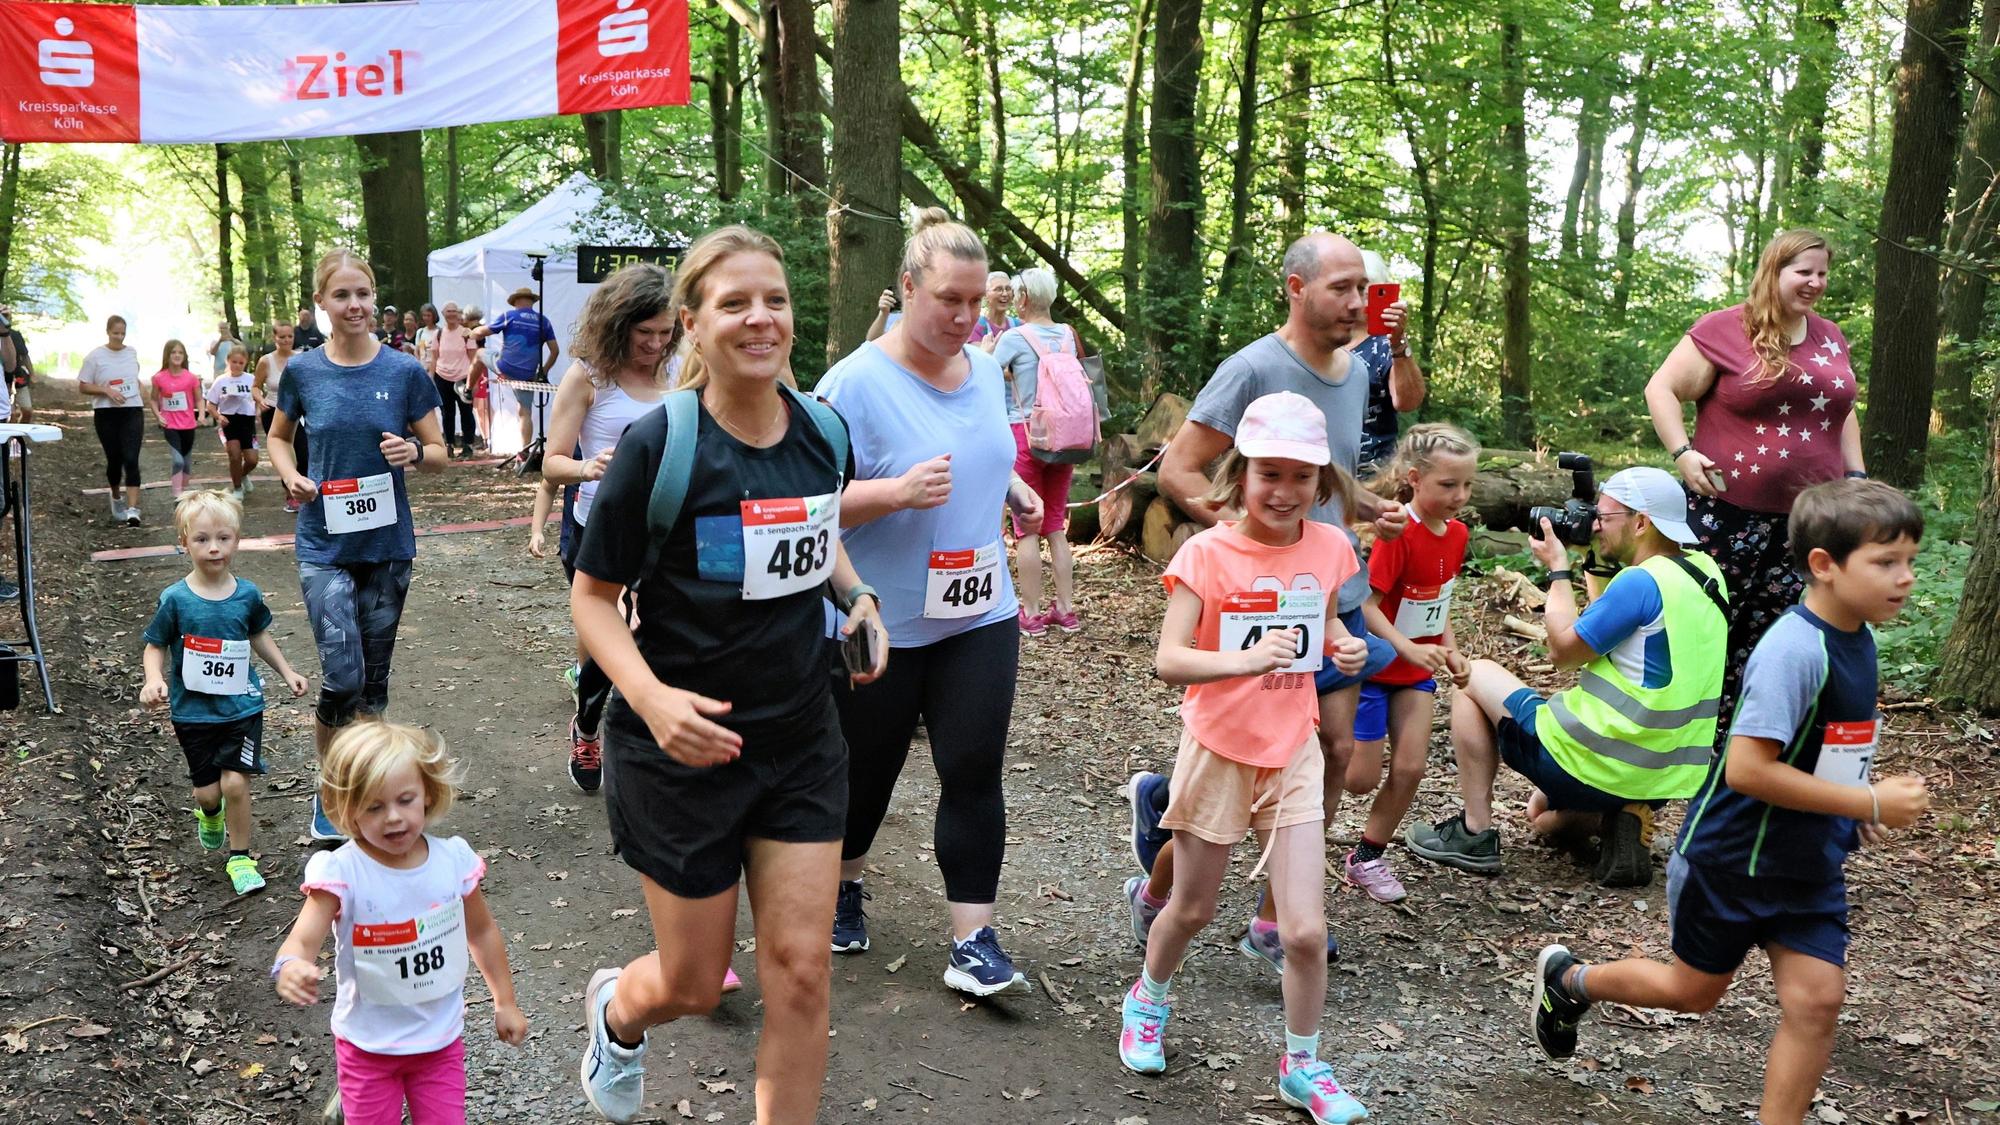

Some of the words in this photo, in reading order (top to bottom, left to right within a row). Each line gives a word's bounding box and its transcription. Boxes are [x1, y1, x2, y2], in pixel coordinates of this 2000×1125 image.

[296, 49, 404, 101] Ziel
[578, 66, 672, 86] Kreissparkasse
[609, 84, 639, 97] Köln
[19, 100, 118, 115] Kreissparkasse
[54, 116, 84, 130] Köln
[345, 496, 377, 516] 380
[767, 528, 829, 581] 483
[942, 571, 993, 608] 484
[1425, 604, 1442, 622] 71
[1241, 623, 1310, 660] 40
[202, 660, 235, 678] 364
[395, 945, 445, 980] 188
